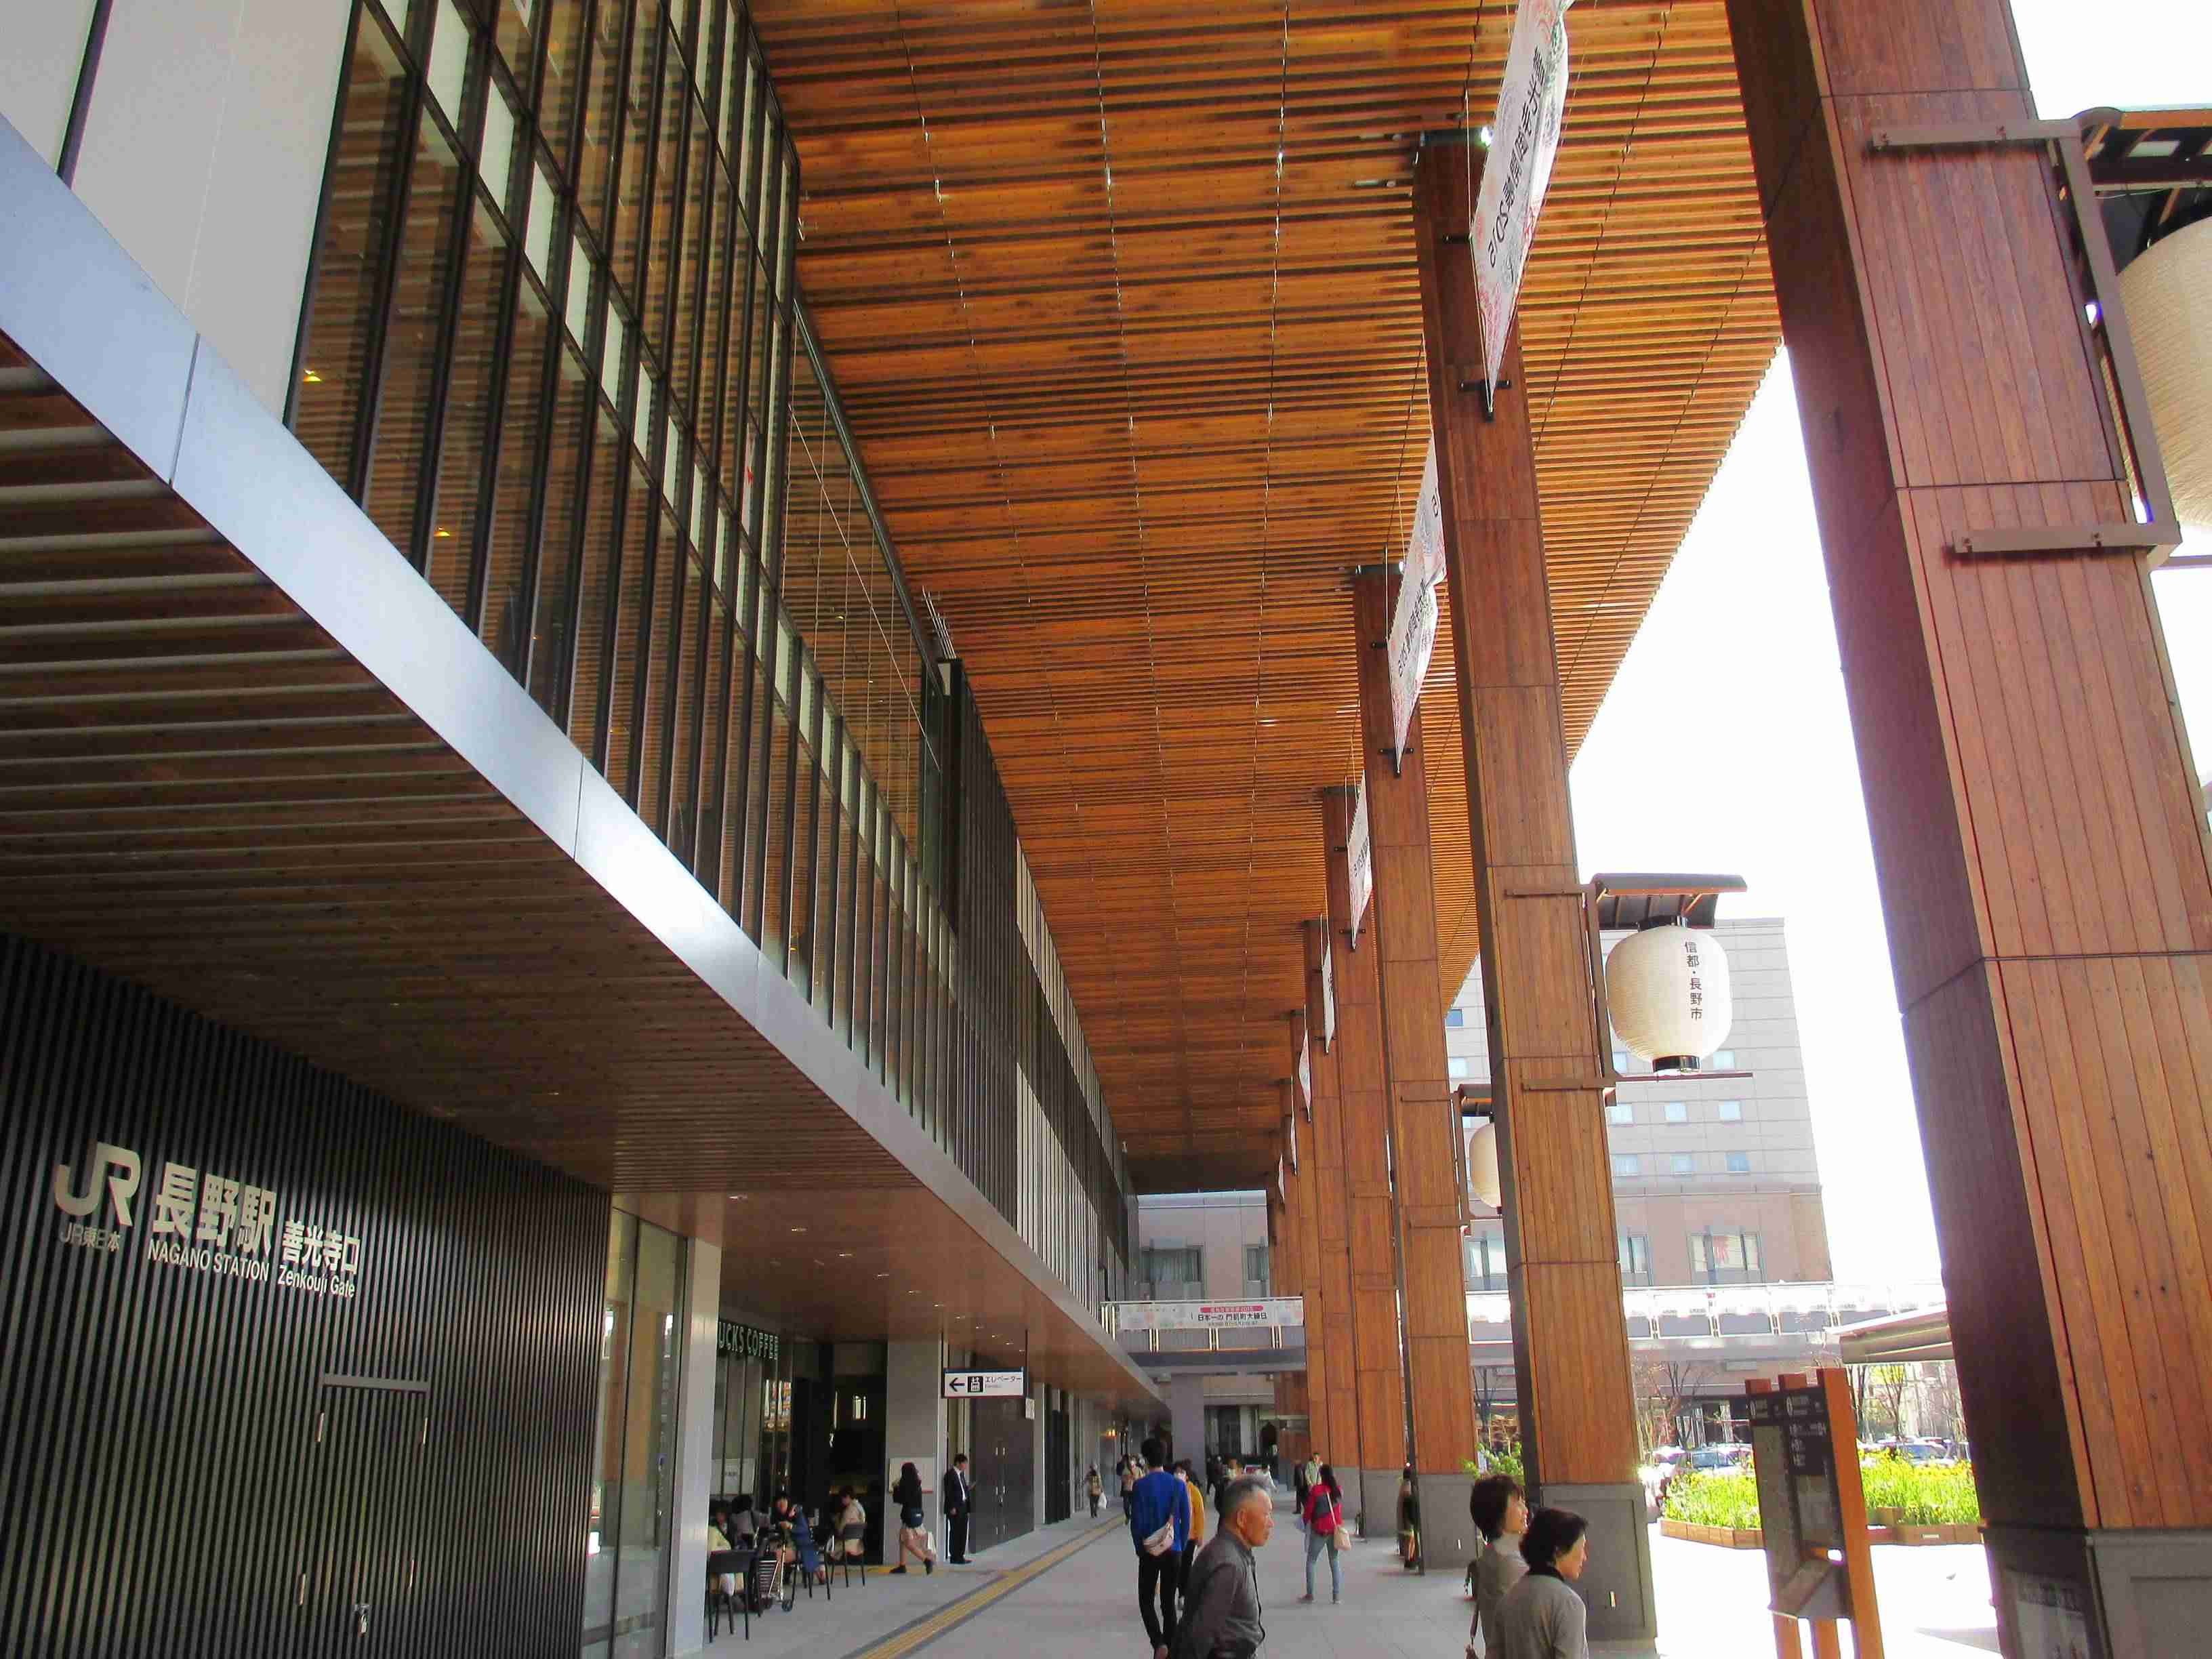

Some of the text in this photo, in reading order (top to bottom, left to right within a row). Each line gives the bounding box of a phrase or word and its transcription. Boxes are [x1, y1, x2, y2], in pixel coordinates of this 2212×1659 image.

[1684, 941, 1703, 1021] 信都・長野市
[54, 1139, 141, 1227] JR
[152, 1162, 277, 1258] 長野駅
[59, 1223, 121, 1252] JR東日本
[147, 1239, 270, 1282] NAGANO STATION
[281, 1218, 361, 1275] 善光寺口
[277, 1264, 356, 1298] Zenkouji Gate
[718, 1321, 779, 1361] UCKS COFFEE
